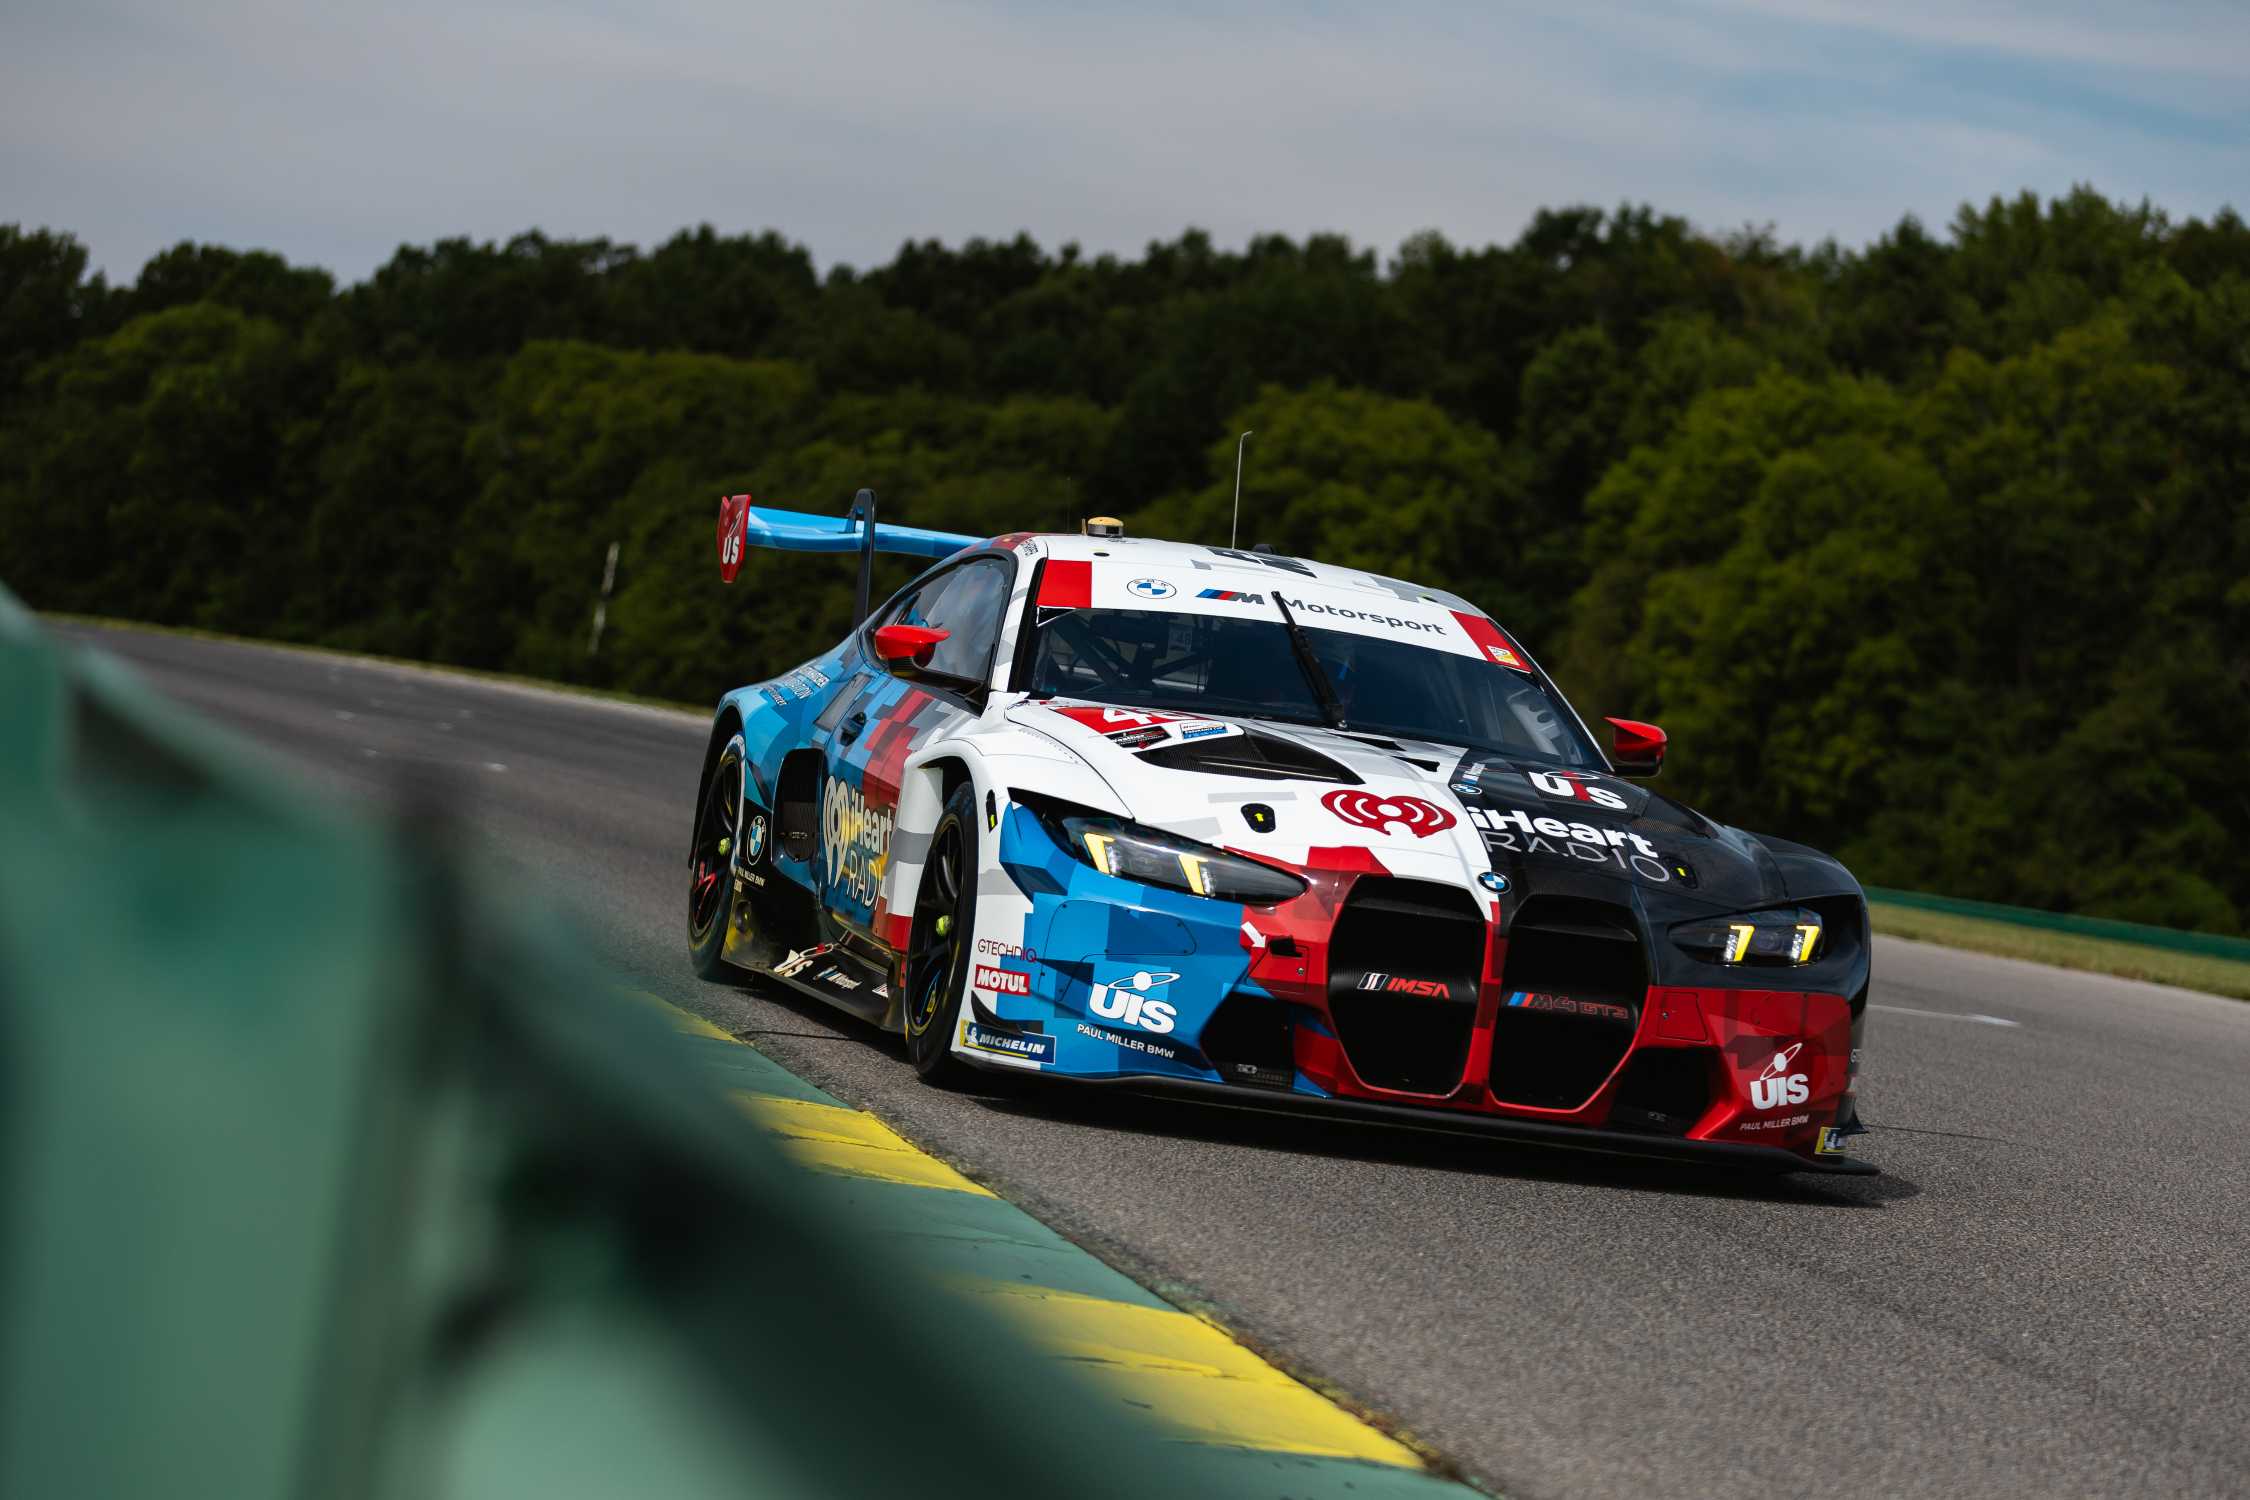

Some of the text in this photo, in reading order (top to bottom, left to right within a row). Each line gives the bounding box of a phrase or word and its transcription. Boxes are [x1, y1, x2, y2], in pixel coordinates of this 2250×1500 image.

[1282, 599, 1447, 636] Motorsport
[851, 787, 892, 857] iHeart
[1466, 806, 1659, 858] iHeart
[1479, 831, 1669, 882] RADIO
[847, 849, 881, 911] RADI
[976, 968, 1028, 993] MOTUL
[1387, 977, 1450, 999] IMSA
[1089, 983, 1177, 1034] UIS
[1579, 1002, 1629, 1019] GT3
[979, 1033, 1046, 1055] MICHELIN
[1077, 1023, 1175, 1060] PAUL MILLER BMW
[1750, 1073, 1809, 1110] UIS
[1740, 1114, 1810, 1131] PAUL MILLER BMW
